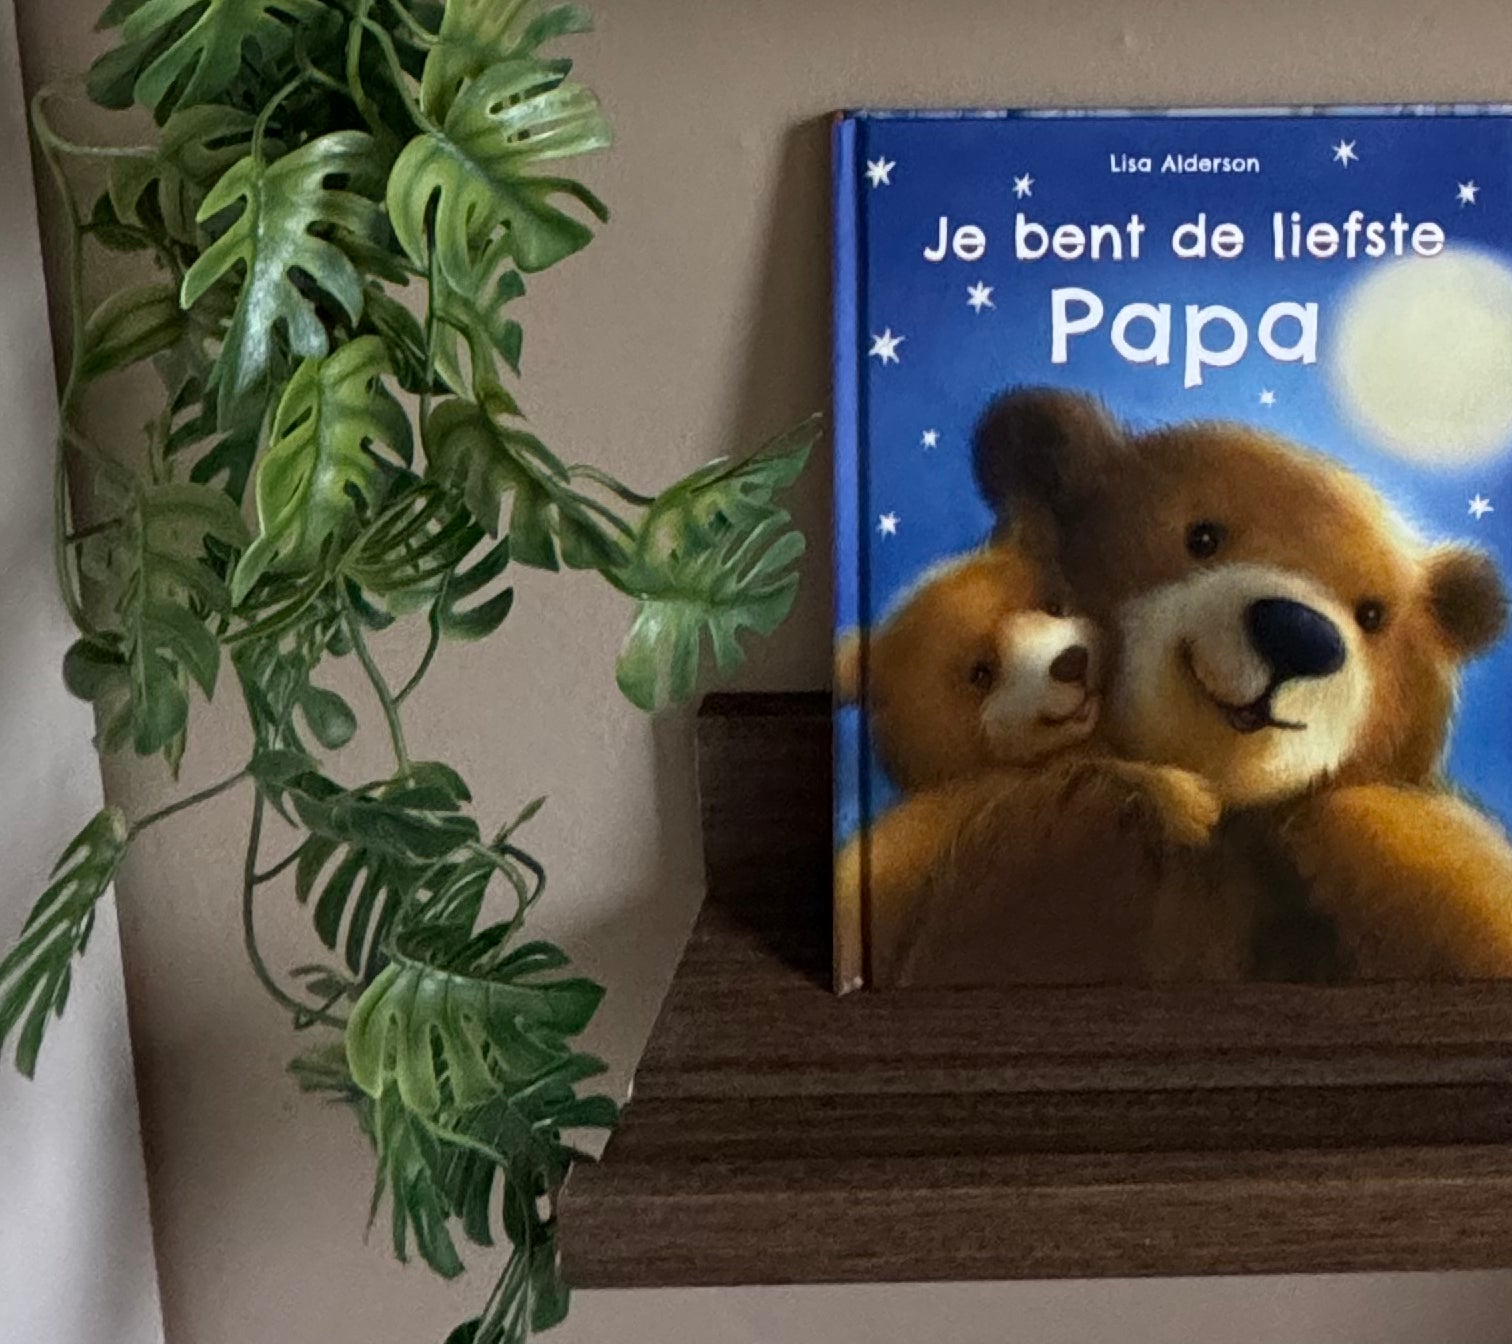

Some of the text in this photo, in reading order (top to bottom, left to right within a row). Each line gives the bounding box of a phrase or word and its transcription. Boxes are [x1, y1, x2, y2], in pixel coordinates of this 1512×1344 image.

[1110, 153, 1260, 174] Lisa Alderson
[923, 210, 1447, 262] Je bent de liefste
[1051, 287, 1319, 389] Papa
